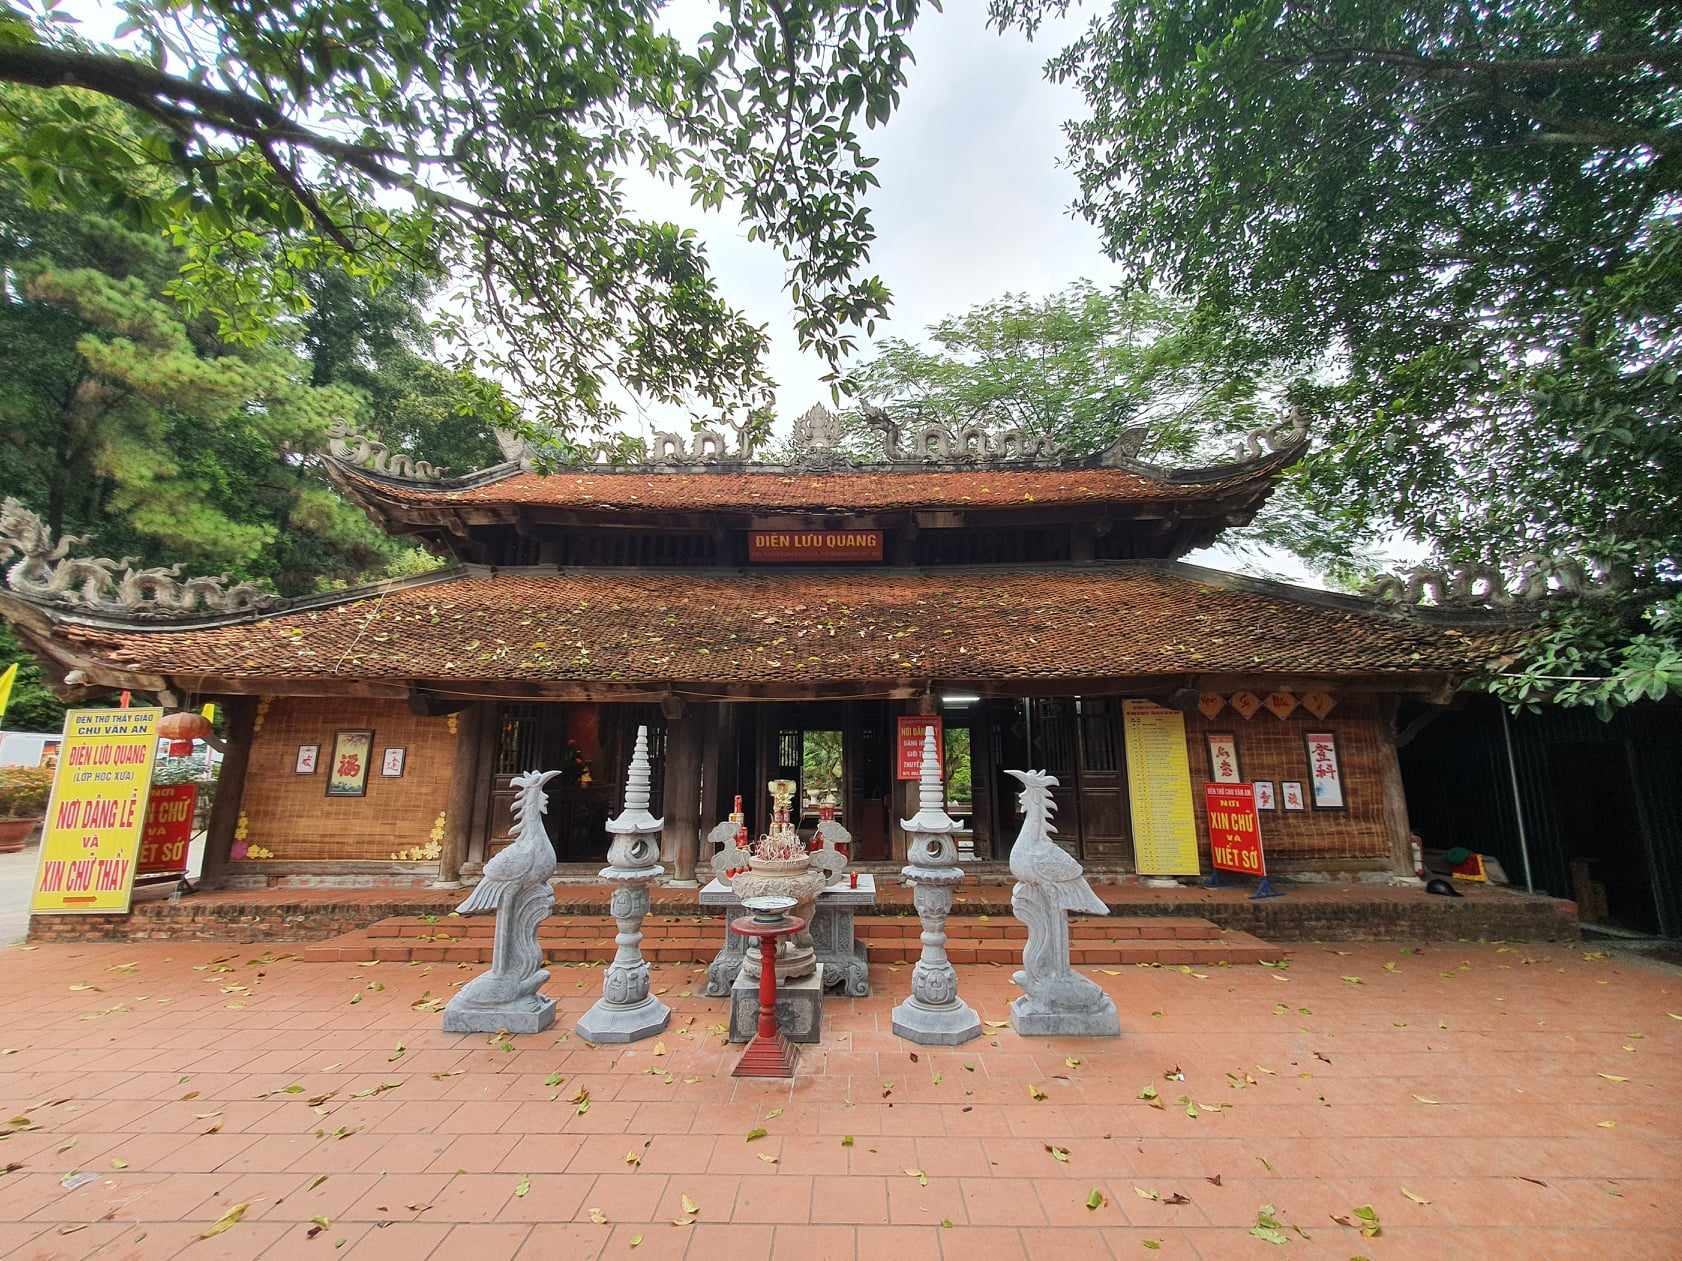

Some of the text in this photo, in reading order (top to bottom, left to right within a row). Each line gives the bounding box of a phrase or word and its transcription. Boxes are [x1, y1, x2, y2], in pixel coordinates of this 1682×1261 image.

[794, 533, 822, 548] LƯU
[826, 534, 877, 548] QUANG
[78, 726, 101, 735] CHU
[130, 725, 148, 734] AN
[93, 744, 112, 766] LƯU
[114, 744, 147, 767] QUANG
[337, 753, 360, 778] 福
[56, 799, 81, 829] NƠI
[159, 796, 191, 823] CHỮ
[1210, 809, 1254, 832] XIN CHỮ
[82, 834, 99, 848] VÀ
[1214, 842, 1239, 867] VIẾT
[39, 848, 129, 892] XIN CHỮ THẦY
